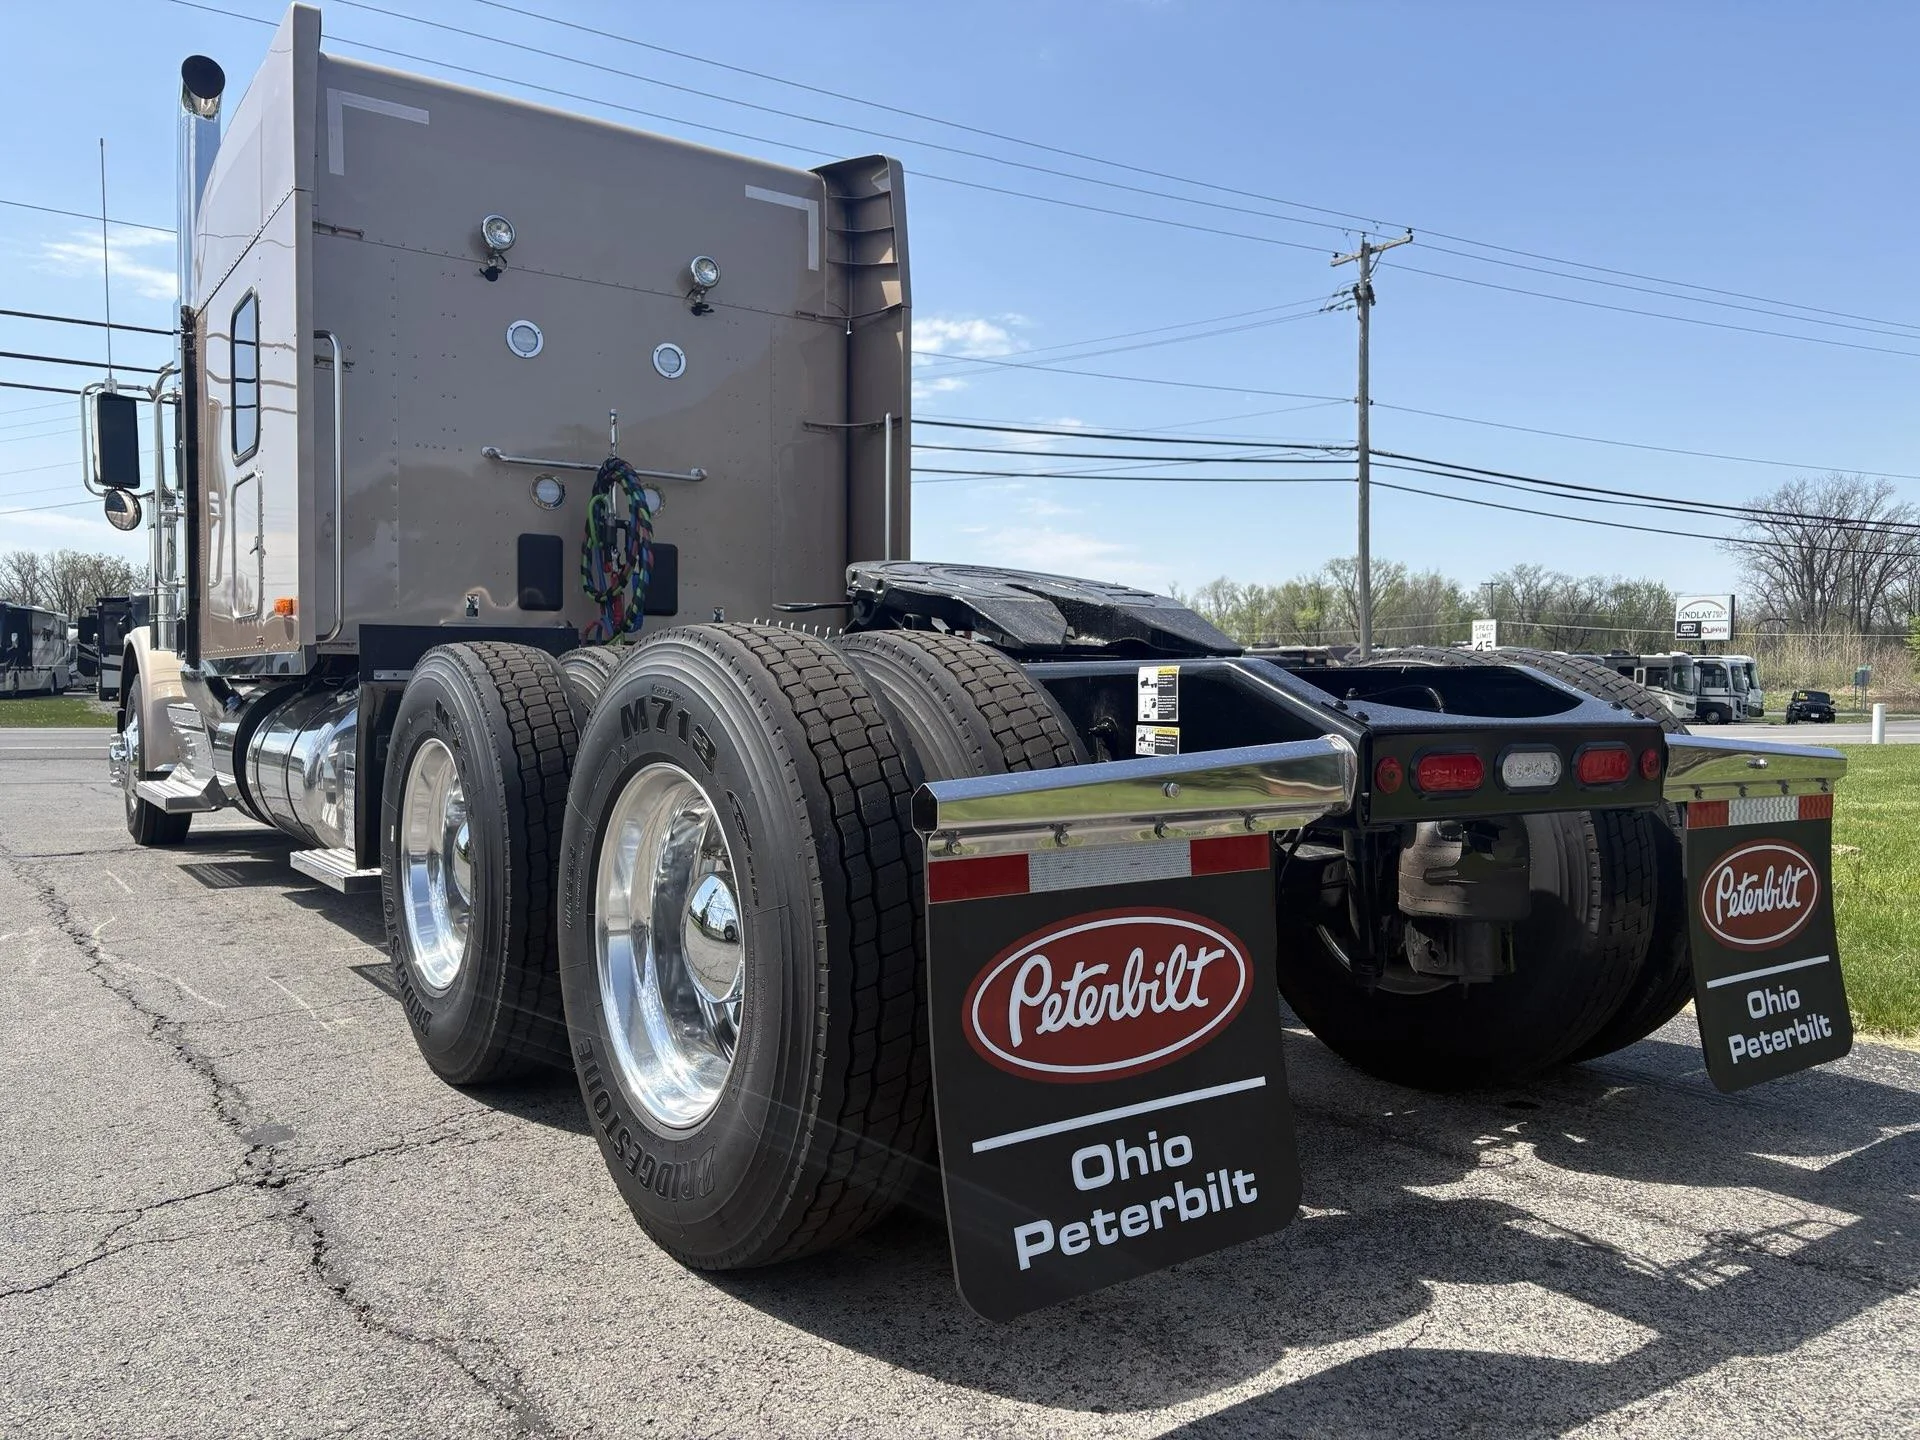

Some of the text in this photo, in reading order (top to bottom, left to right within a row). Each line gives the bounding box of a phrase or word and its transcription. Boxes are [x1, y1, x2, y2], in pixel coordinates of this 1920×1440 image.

[1475, 640, 1493, 652] 45
[1678, 611, 1712, 619] FINDLAY
[620, 694, 718, 775] M713
[1715, 864, 1808, 926] Peterbilt
[1008, 943, 1226, 1048] Peterbilt
[1747, 984, 1800, 1020] Ohio
[1728, 1012, 1833, 1065] Peterbilt
[575, 1036, 716, 1201] BRIDGESTONE
[1071, 1130, 1194, 1193] Ohio
[1013, 1167, 1258, 1271] Peterbilt
